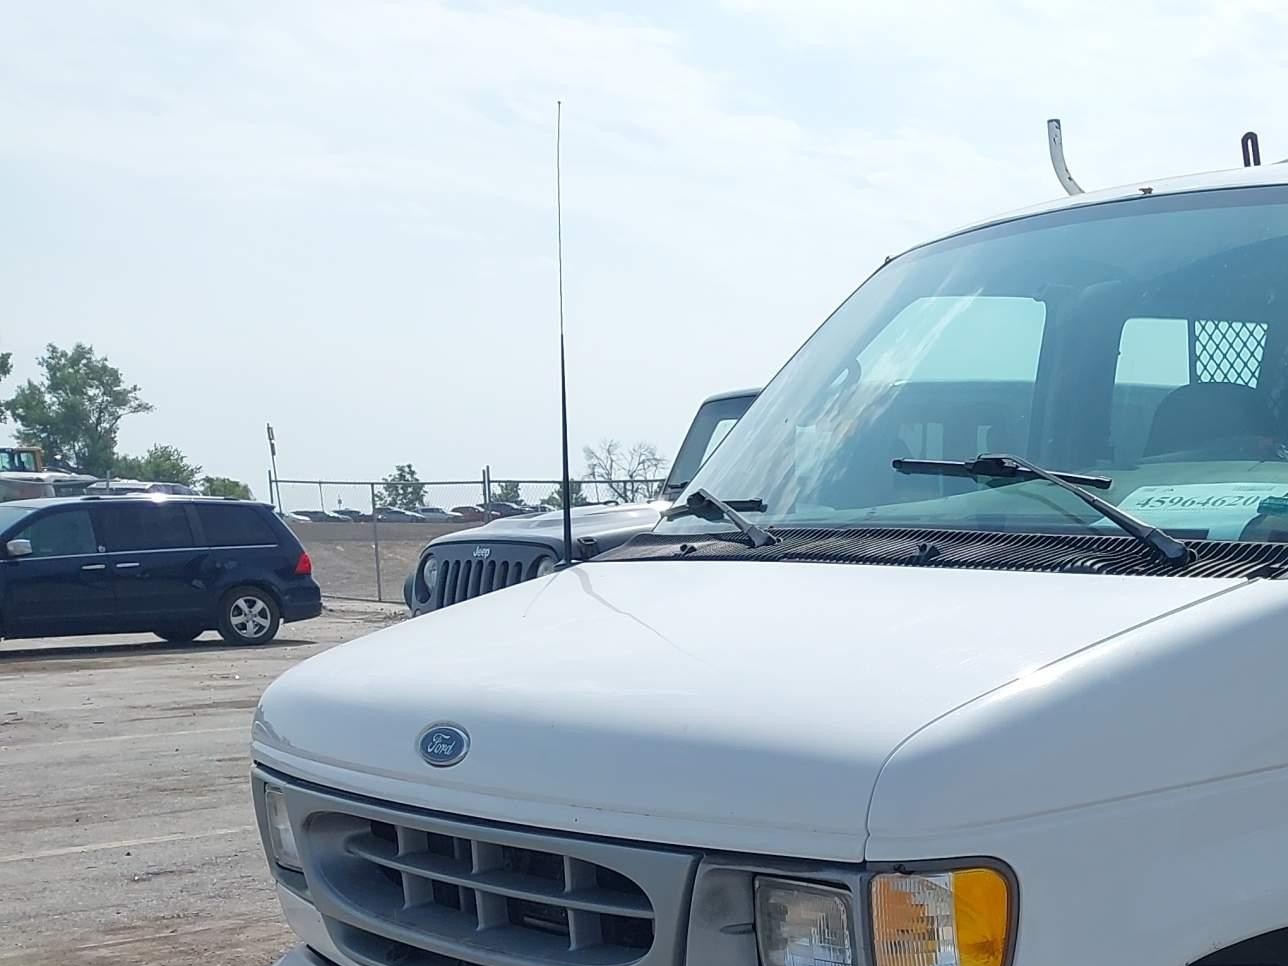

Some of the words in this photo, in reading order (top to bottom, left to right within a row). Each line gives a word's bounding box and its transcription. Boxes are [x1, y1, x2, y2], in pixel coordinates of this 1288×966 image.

[1136, 495, 1260, 508] 45964620
[473, 545, 490, 559] Jeep
[428, 733, 456, 755] Ford
